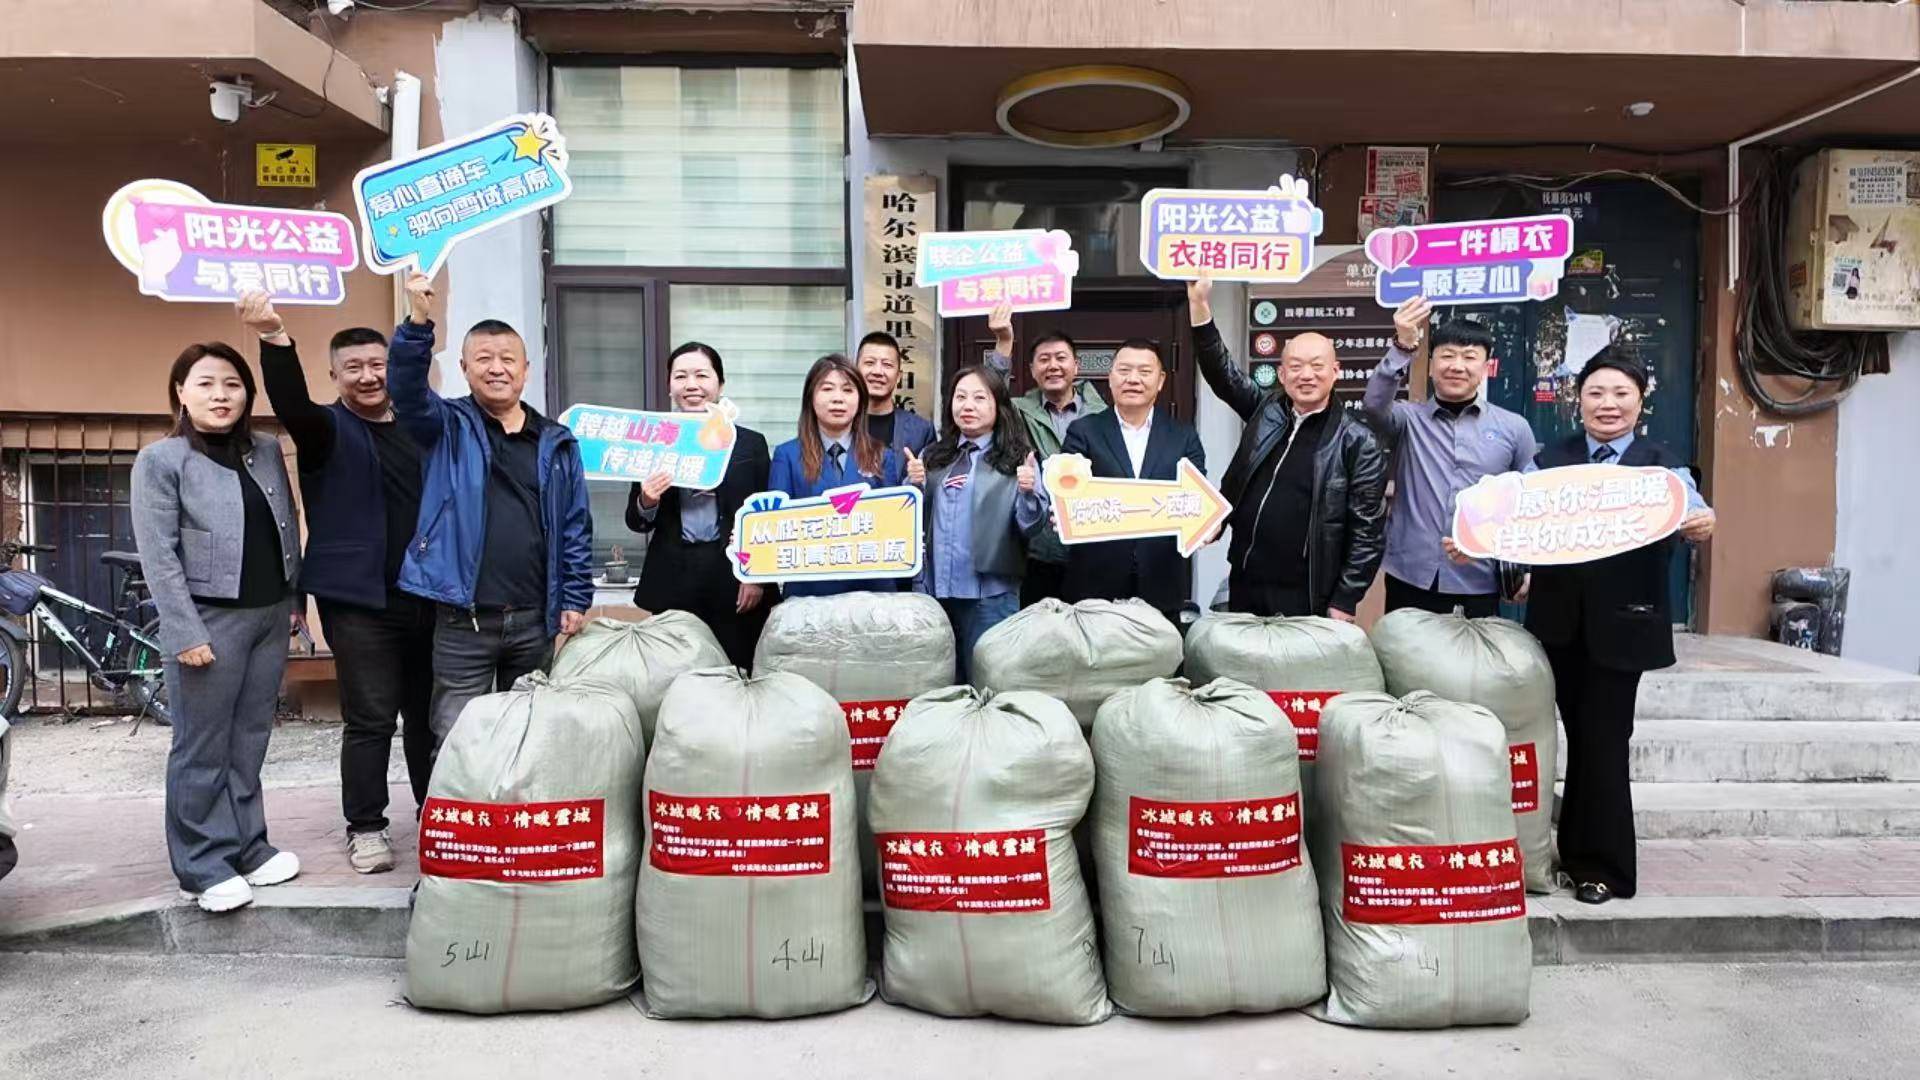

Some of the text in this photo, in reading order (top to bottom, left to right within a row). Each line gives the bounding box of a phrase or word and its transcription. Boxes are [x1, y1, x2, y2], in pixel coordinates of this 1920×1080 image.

[368, 157, 490, 219] 爱心直通车
[406, 167, 553, 239] 驶向雪域高原
[185, 211, 343, 257] 阳光公益
[1157, 202, 1281, 235] 阳光公益
[1169, 239, 1293, 271] 衣路同行
[1427, 224, 1553, 256] 一件棉衣
[193, 258, 331, 297] 与爱同行
[955, 275, 1054, 302] 与爱同行
[1390, 265, 1521, 297] 一颗爱心
[574, 411, 681, 446] 跨越山海
[600, 446, 706, 482] 传递温暖
[1517, 471, 1669, 519] 愿你温暖
[1494, 512, 1650, 556] 伴你成长
[776, 539, 906, 569] 到青藏高原
